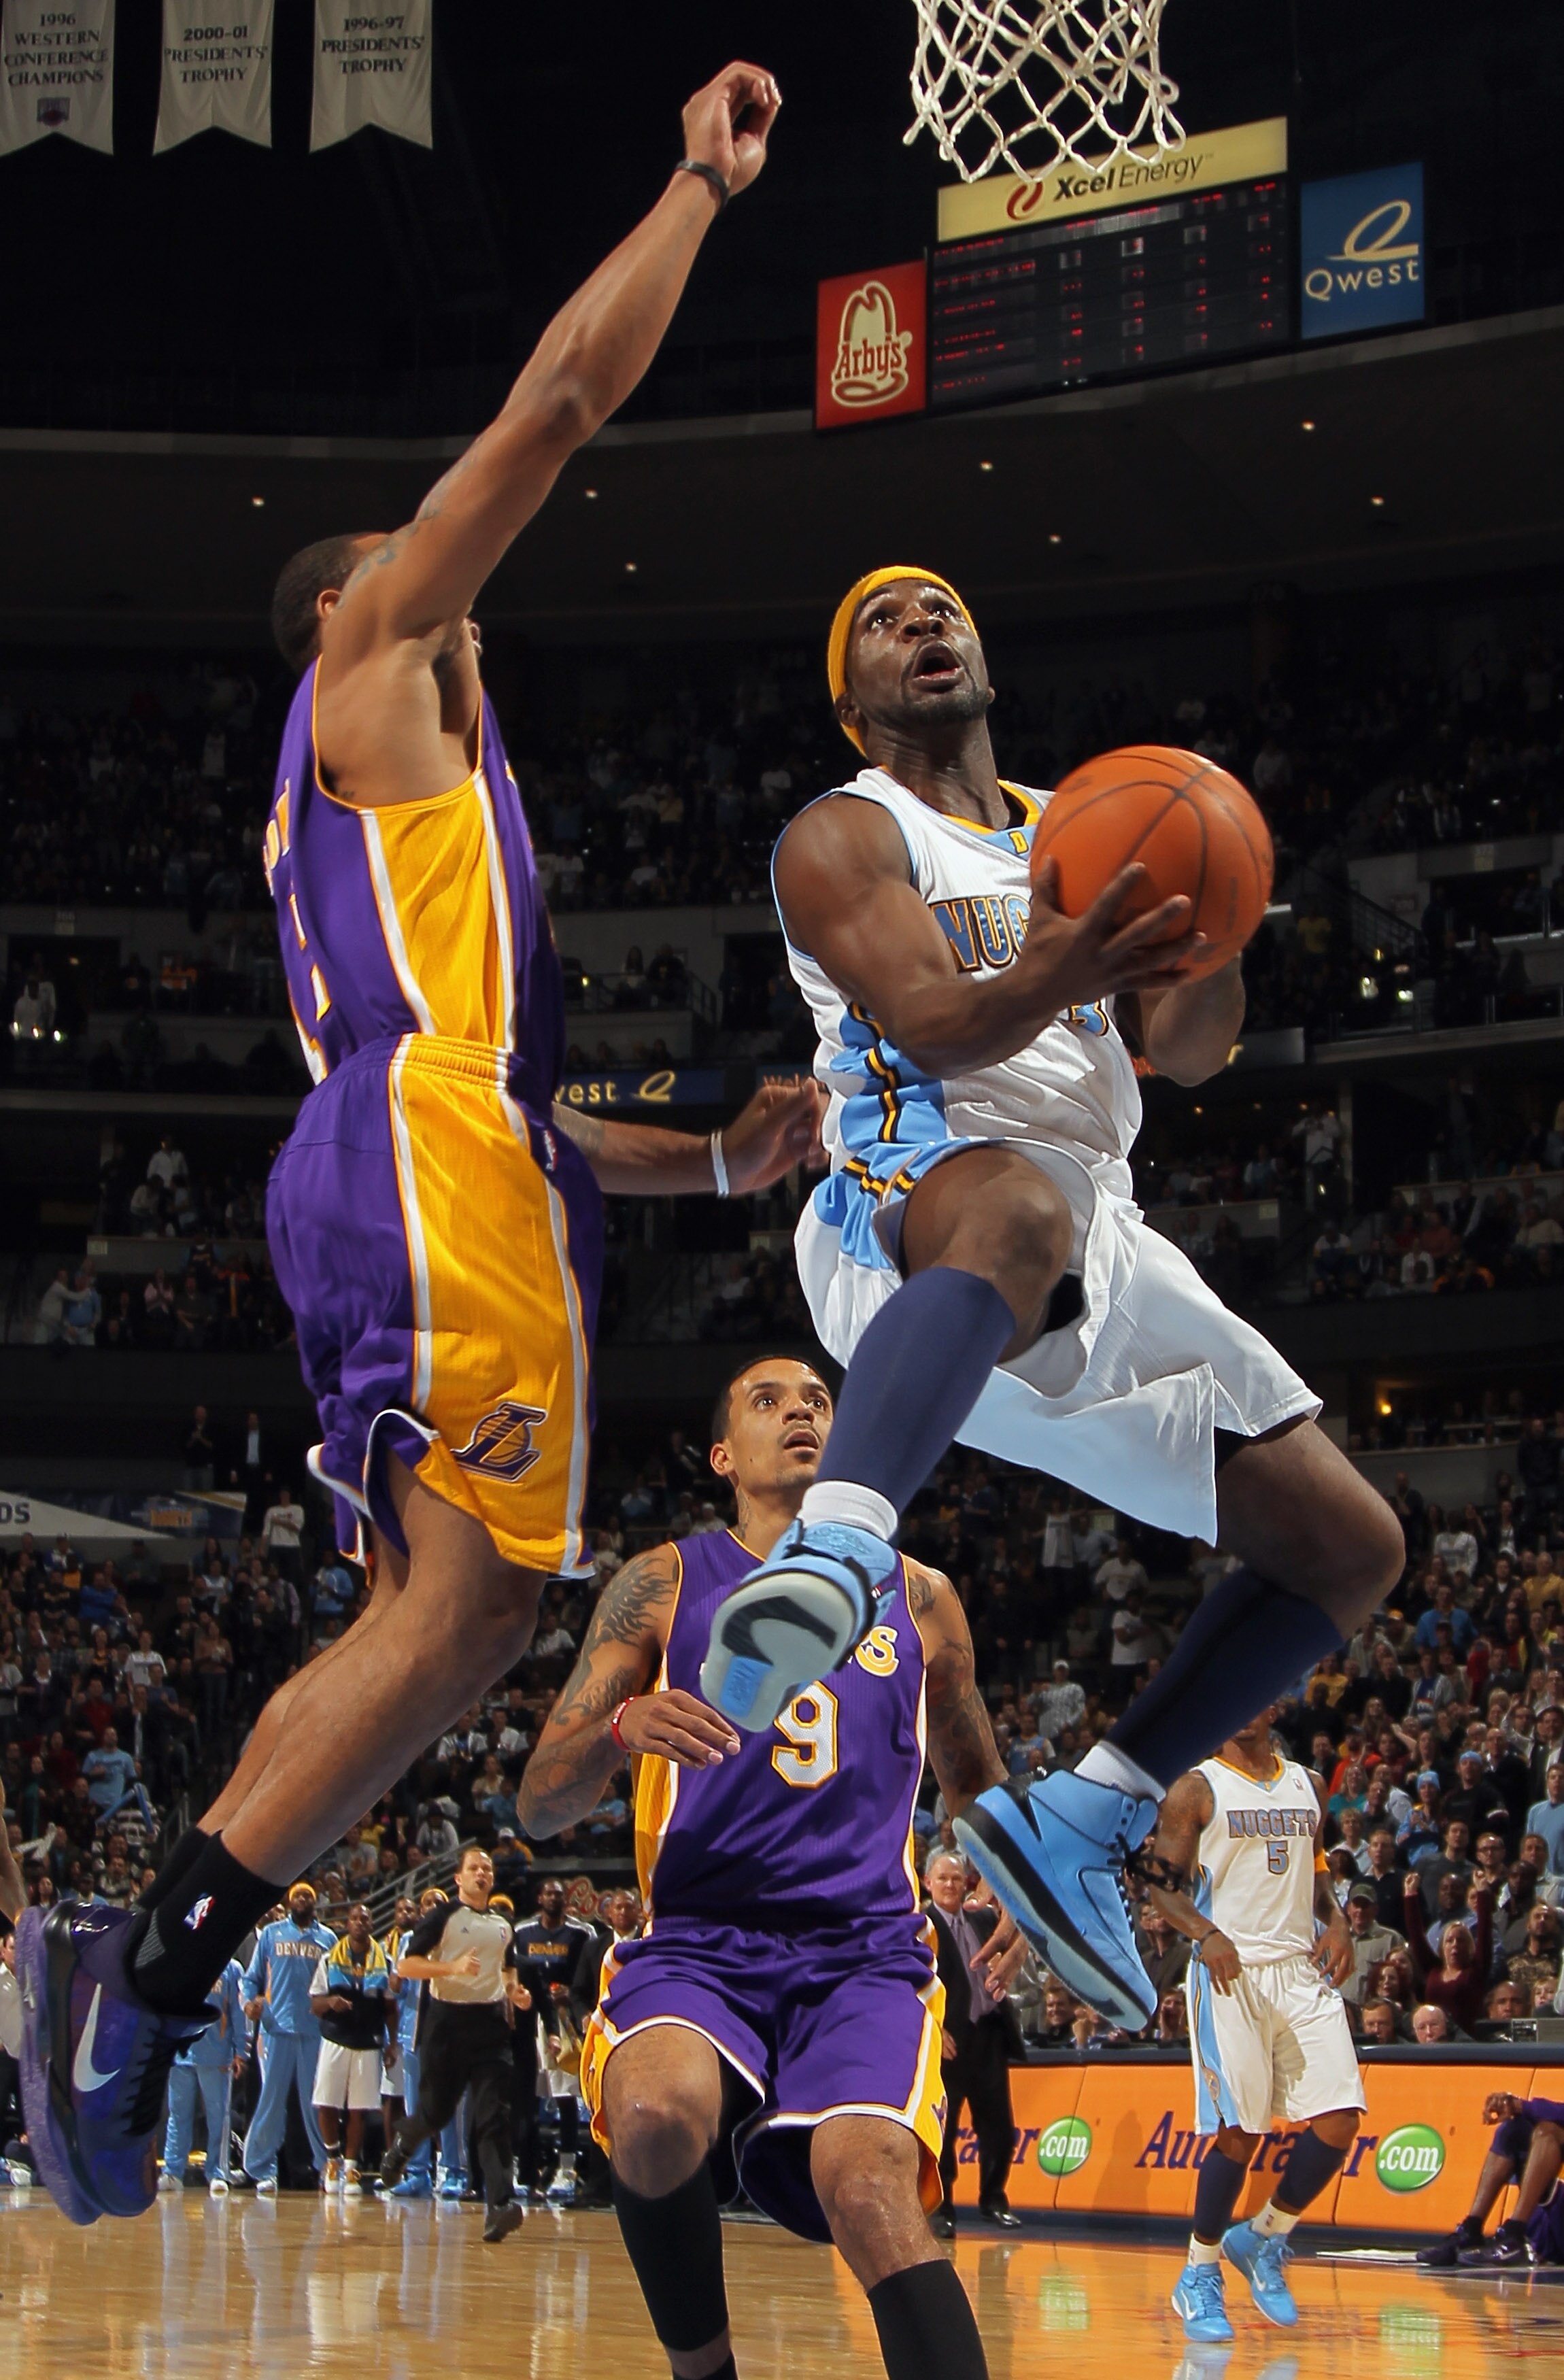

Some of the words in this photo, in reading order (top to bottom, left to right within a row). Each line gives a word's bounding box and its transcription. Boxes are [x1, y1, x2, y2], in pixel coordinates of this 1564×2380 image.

[39, 13, 76, 27] 1996
[343, 16, 405, 32] 1996-97
[14, 30, 101, 45] WESTERN
[184, 25, 249, 41] 2000-01
[322, 37, 425, 53] PRESIDENTS'
[4, 48, 108, 66] CONFERENCE
[340, 58, 407, 73] TROPHY
[7, 69, 105, 86] CHAMPIONS
[180, 67, 248, 83] TROPHY
[1054, 168, 1116, 201] Xcel
[1119, 155, 1204, 187] Energy
[1305, 260, 1419, 301] Qwest
[772, 1680, 839, 1789] 9
[1226, 1809, 1318, 1838] NUGGETS
[1267, 1840, 1290, 1874] 5
[275, 1943, 324, 1960] DENVER
[1039, 2134, 1088, 2159] .com
[1379, 2145, 1440, 2173] .com
